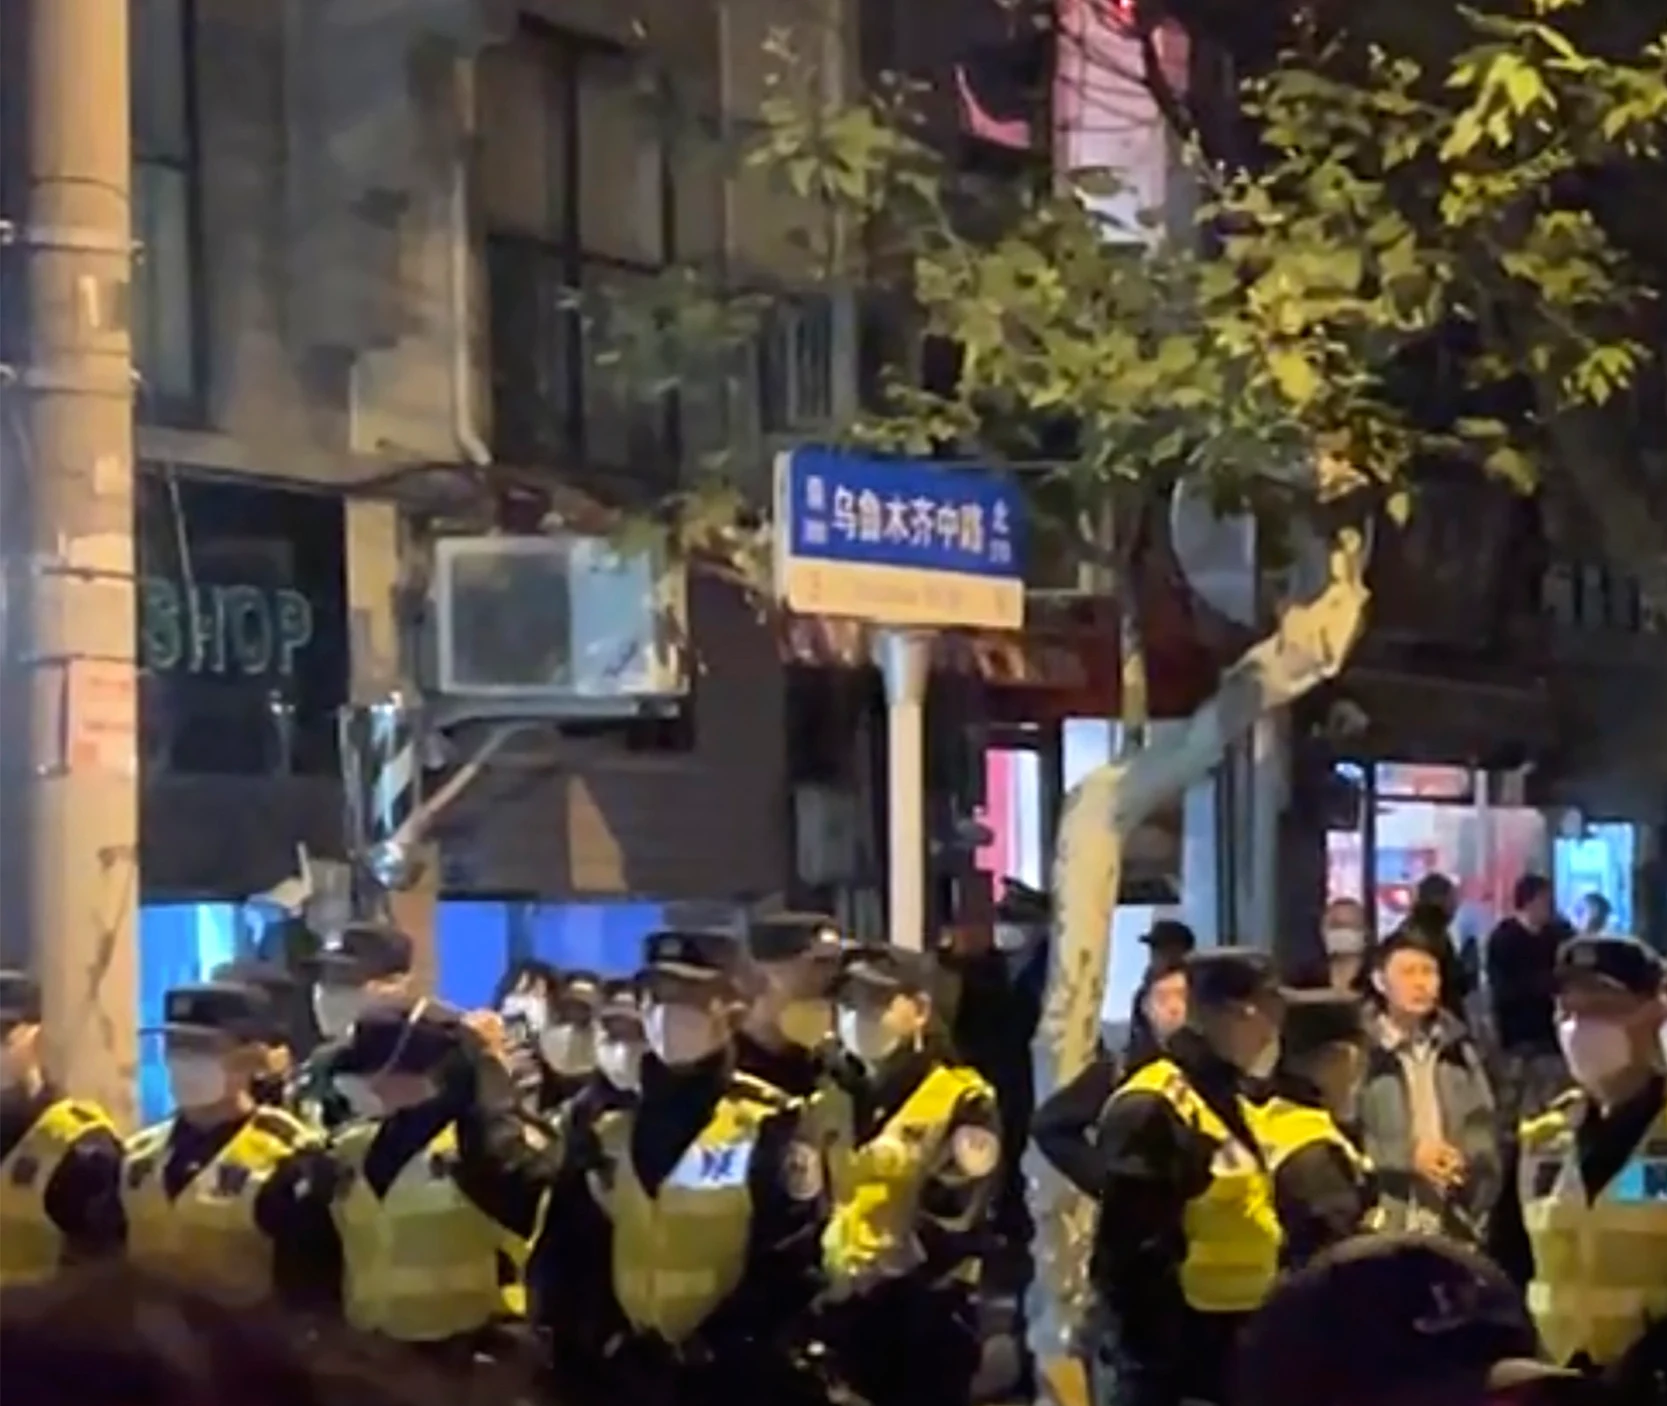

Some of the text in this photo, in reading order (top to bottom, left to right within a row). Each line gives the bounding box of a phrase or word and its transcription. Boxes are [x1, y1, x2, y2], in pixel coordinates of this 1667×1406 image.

[833, 485, 984, 553] 乌鲁木齐中路
[142, 576, 313, 674] SHOP
